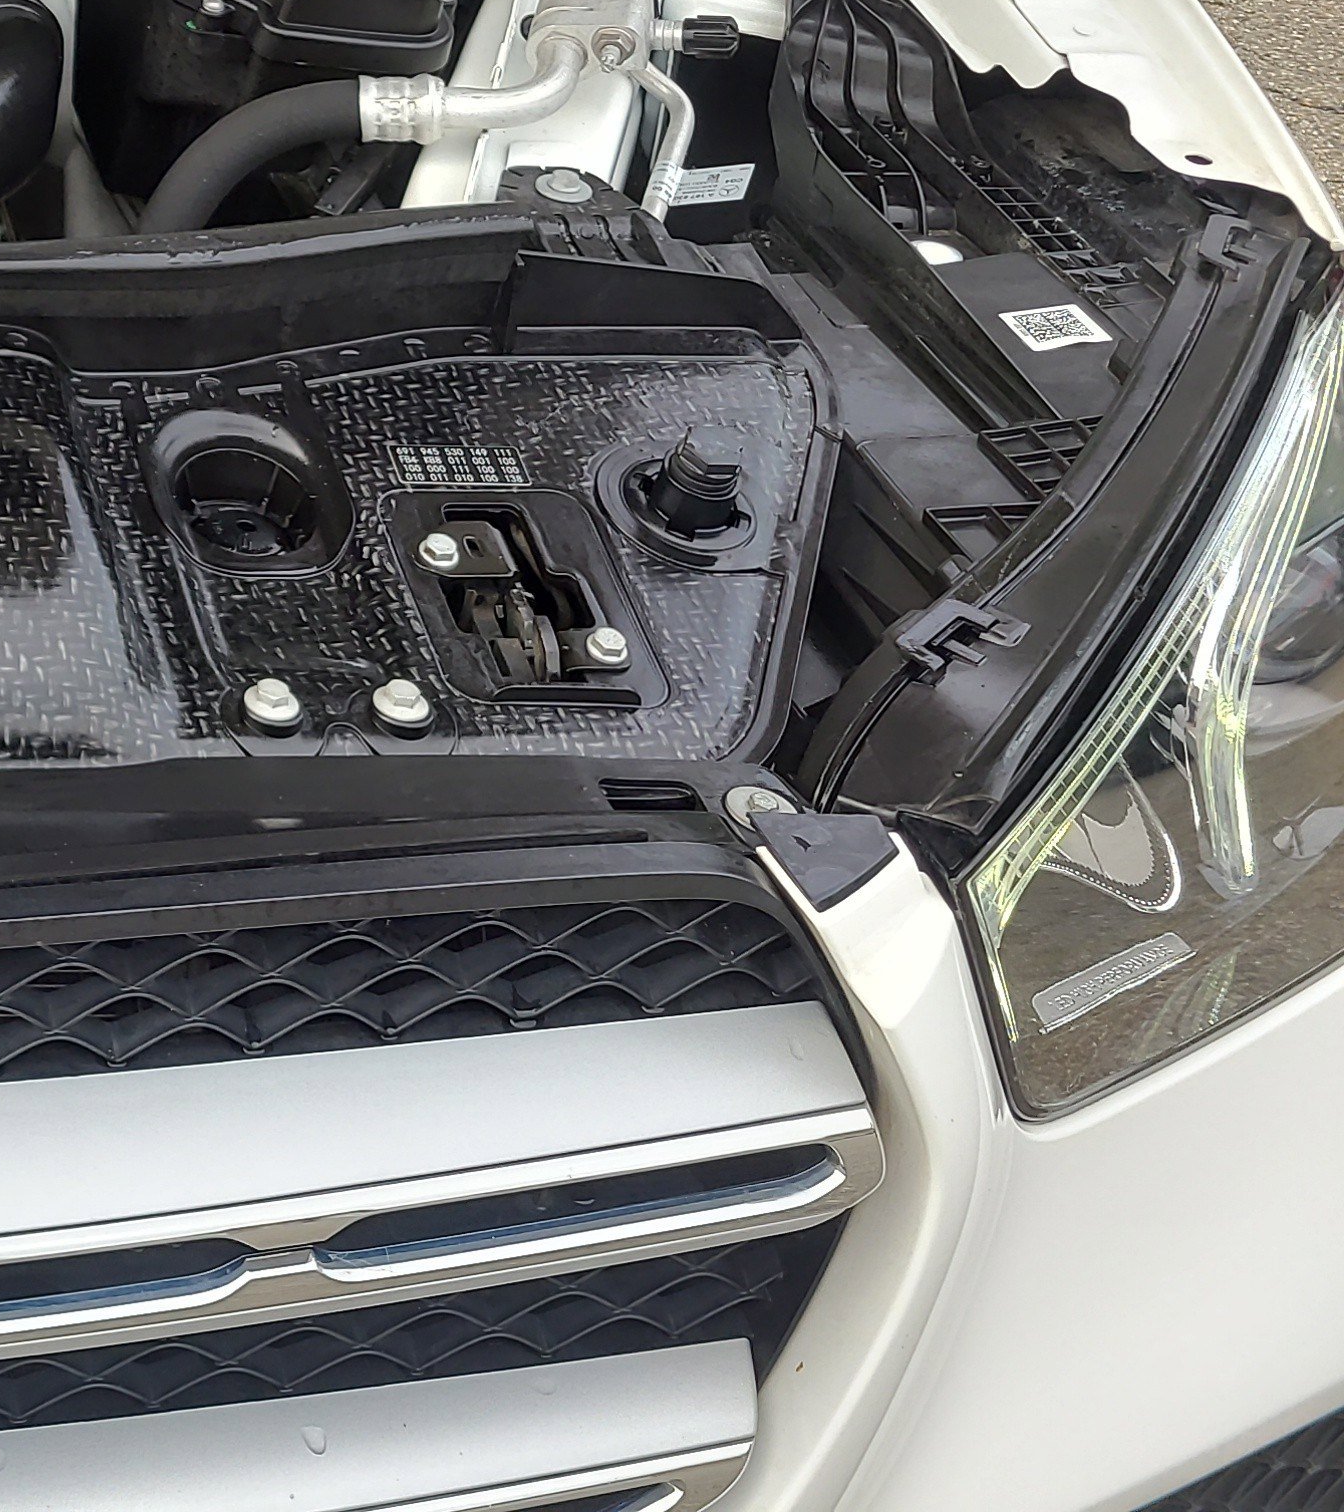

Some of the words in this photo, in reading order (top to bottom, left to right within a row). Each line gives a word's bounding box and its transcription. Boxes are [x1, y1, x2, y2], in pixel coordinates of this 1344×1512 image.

[396, 447, 414, 455] 691
[419, 448, 440, 456] 945
[444, 448, 464, 456] 530
[469, 448, 487, 456] 149
[493, 449, 512, 457] 111
[472, 457, 490, 465] 001
[497, 457, 516, 465] 100
[403, 464, 422, 472] 100
[426, 464, 446, 473] 000
[452, 465, 470, 473] 111
[476, 465, 495, 474] 100
[500, 466, 520, 474] 100
[405, 473, 425, 481] 010
[430, 473, 449, 482] 011
[454, 474, 474, 482] 010
[479, 474, 499, 482] 100
[505, 475, 524, 483] 138
